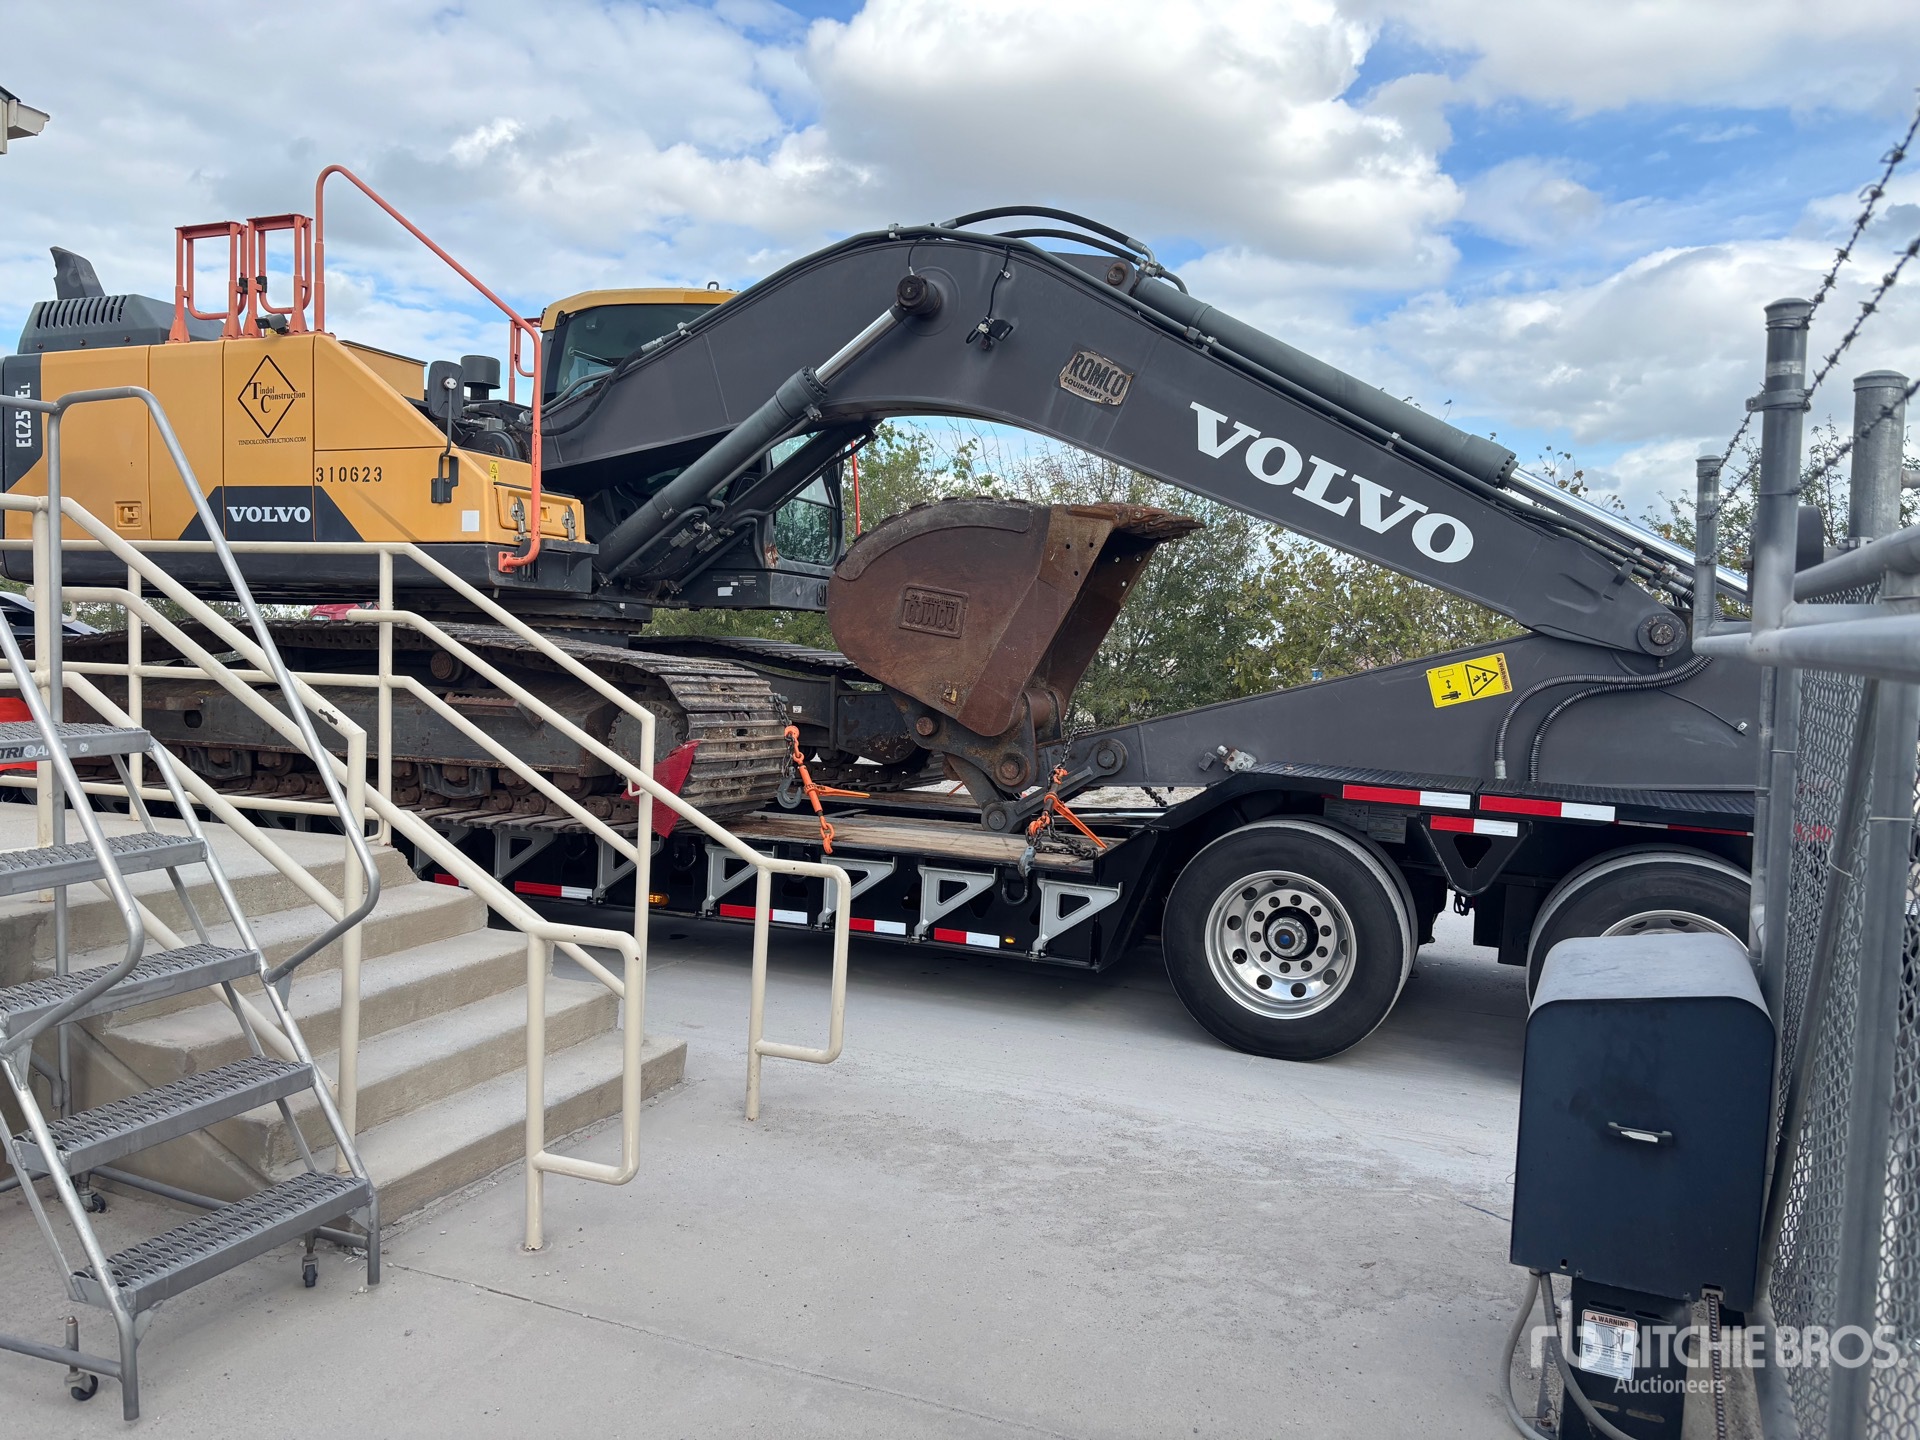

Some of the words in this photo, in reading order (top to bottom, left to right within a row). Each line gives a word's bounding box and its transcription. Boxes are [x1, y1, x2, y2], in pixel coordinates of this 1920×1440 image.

[1068, 353, 1127, 397] ROMCO
[249, 381, 275, 400] Tindol
[1063, 377, 1103, 399] EQUIPMENT
[260, 390, 306, 414] Construction
[15, 382, 32, 448] EC25EL
[238, 437, 307, 446] TINDOLCONSTRUCTION.COM
[315, 466, 383, 482] 310623
[1190, 401, 1474, 563] VOLVO
[227, 506, 311, 523] VOLVO
[1498, 662, 1510, 690] WARNING
[1597, 1315, 1629, 1327] WARNING
